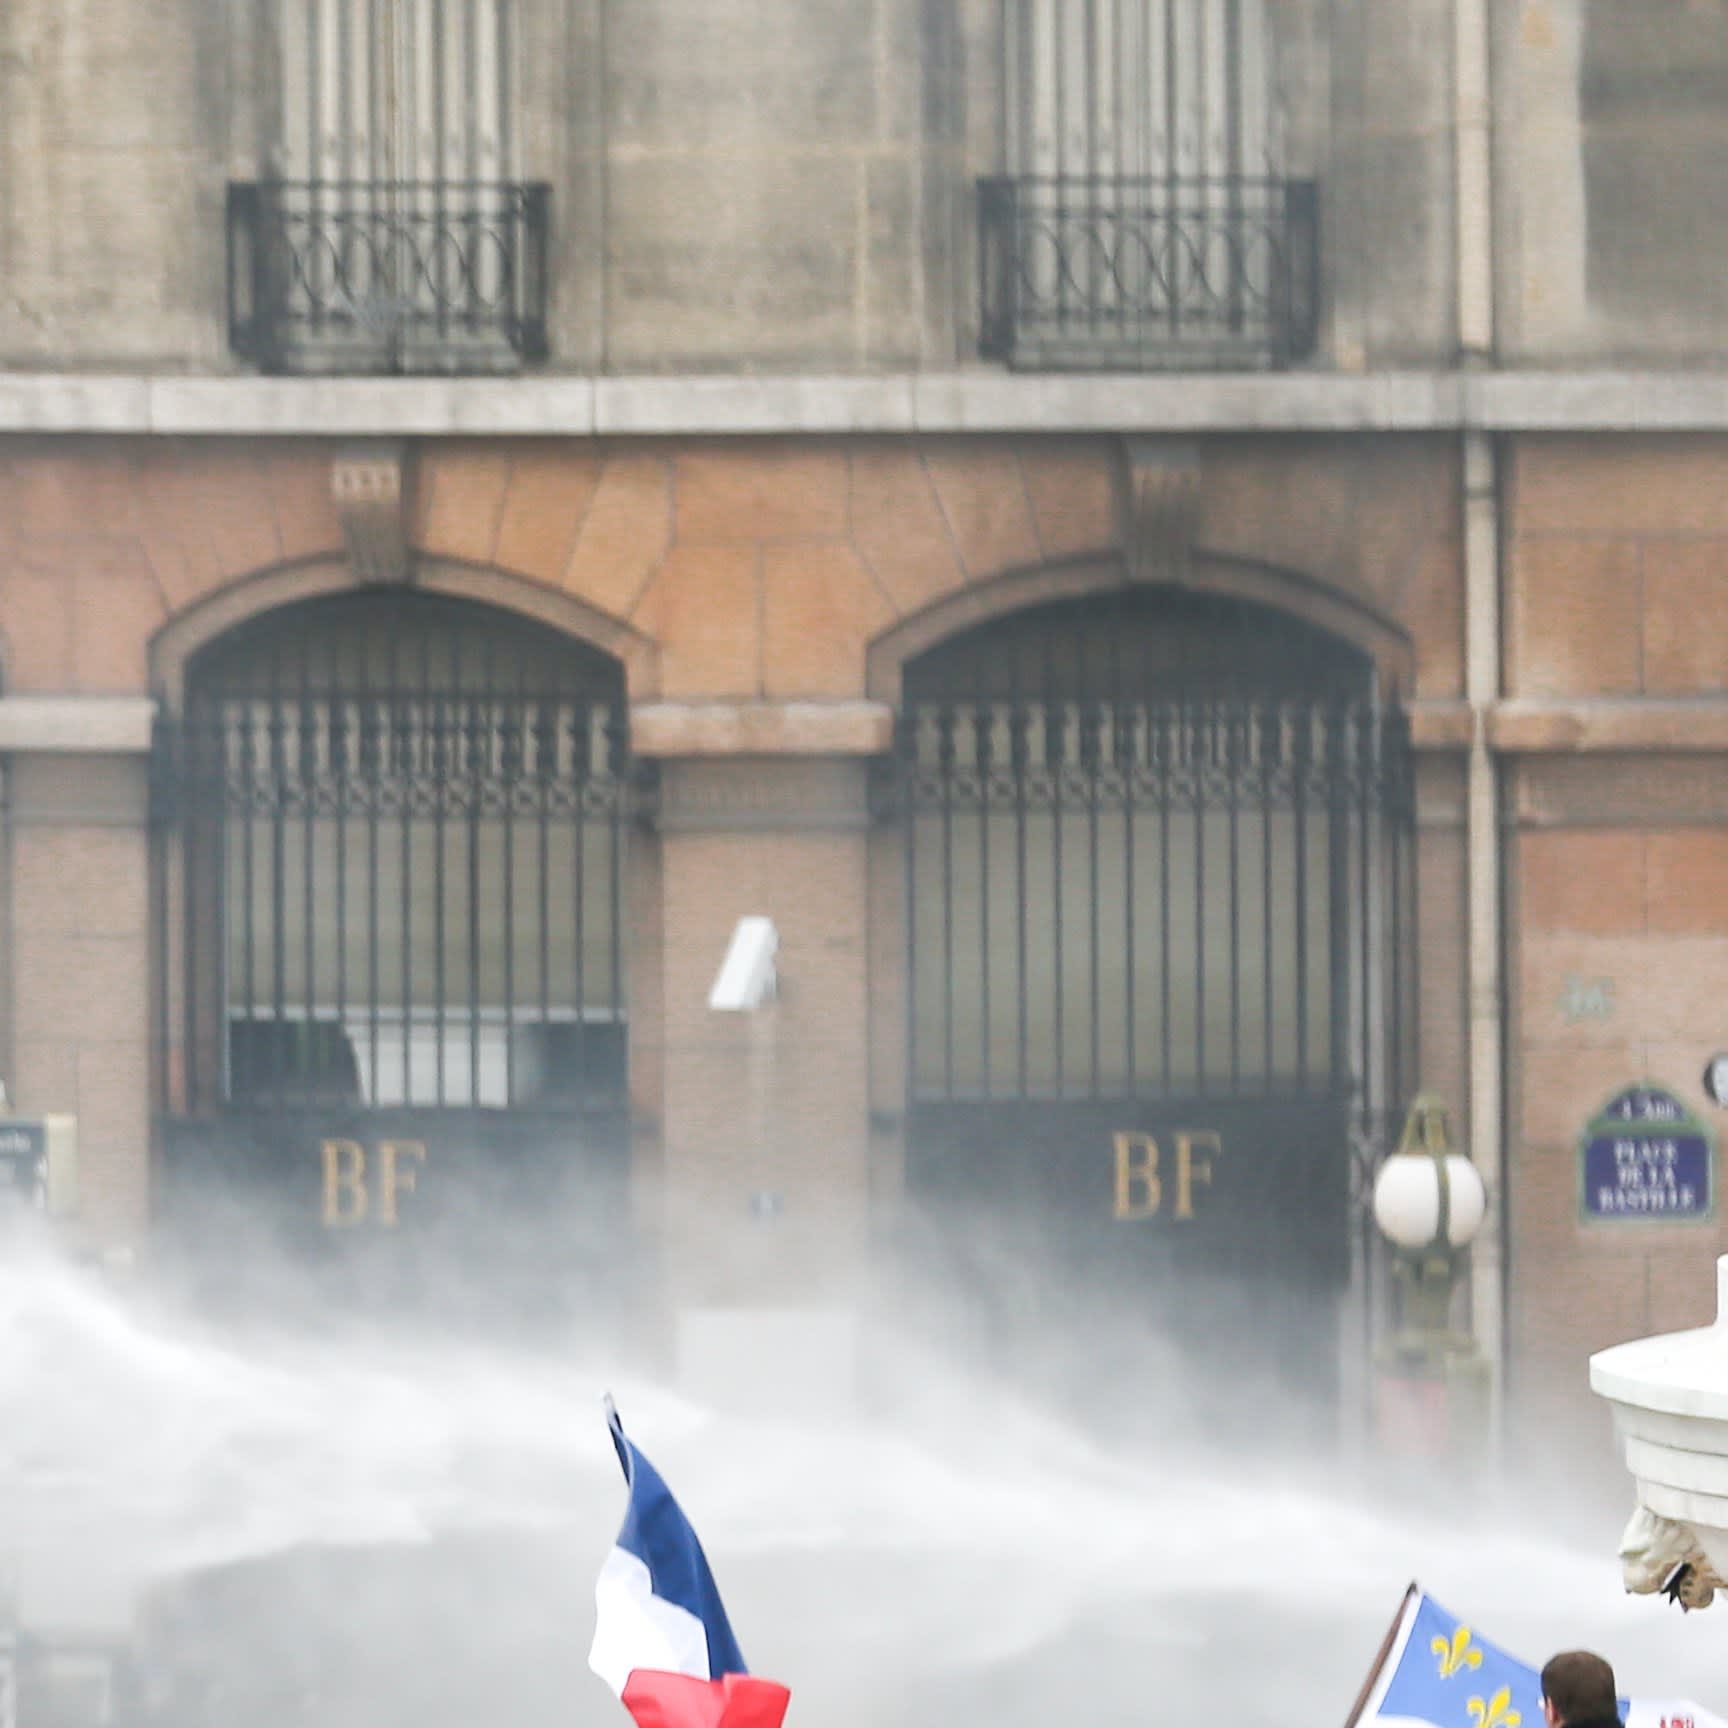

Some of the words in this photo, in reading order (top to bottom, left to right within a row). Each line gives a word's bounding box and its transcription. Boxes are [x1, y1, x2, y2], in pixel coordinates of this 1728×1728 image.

[1112, 1128, 1224, 1222] BF
[1614, 1140, 1678, 1164] PLACE
[320, 1137, 428, 1230] BF
[1599, 1187, 1695, 1212] BASTILLE
